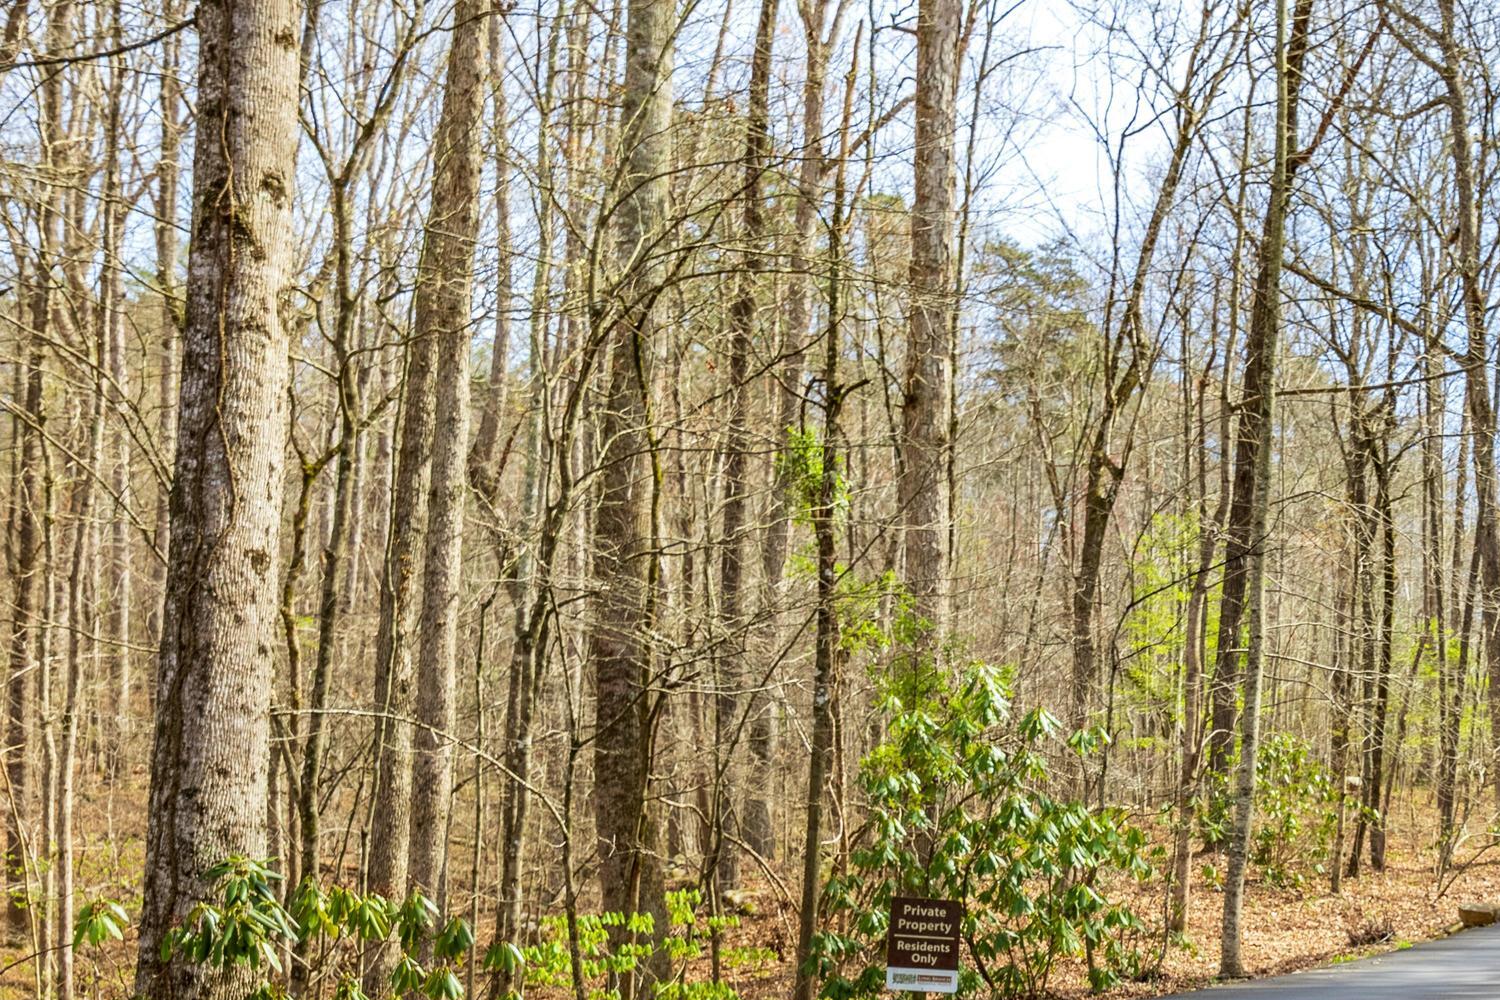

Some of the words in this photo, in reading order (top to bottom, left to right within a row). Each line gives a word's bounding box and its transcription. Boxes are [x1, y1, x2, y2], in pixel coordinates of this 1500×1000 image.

[904, 905, 946, 917] Private
[898, 918, 952, 934] Property
[897, 940, 950, 953] Residents
[912, 953, 937, 966] Only
